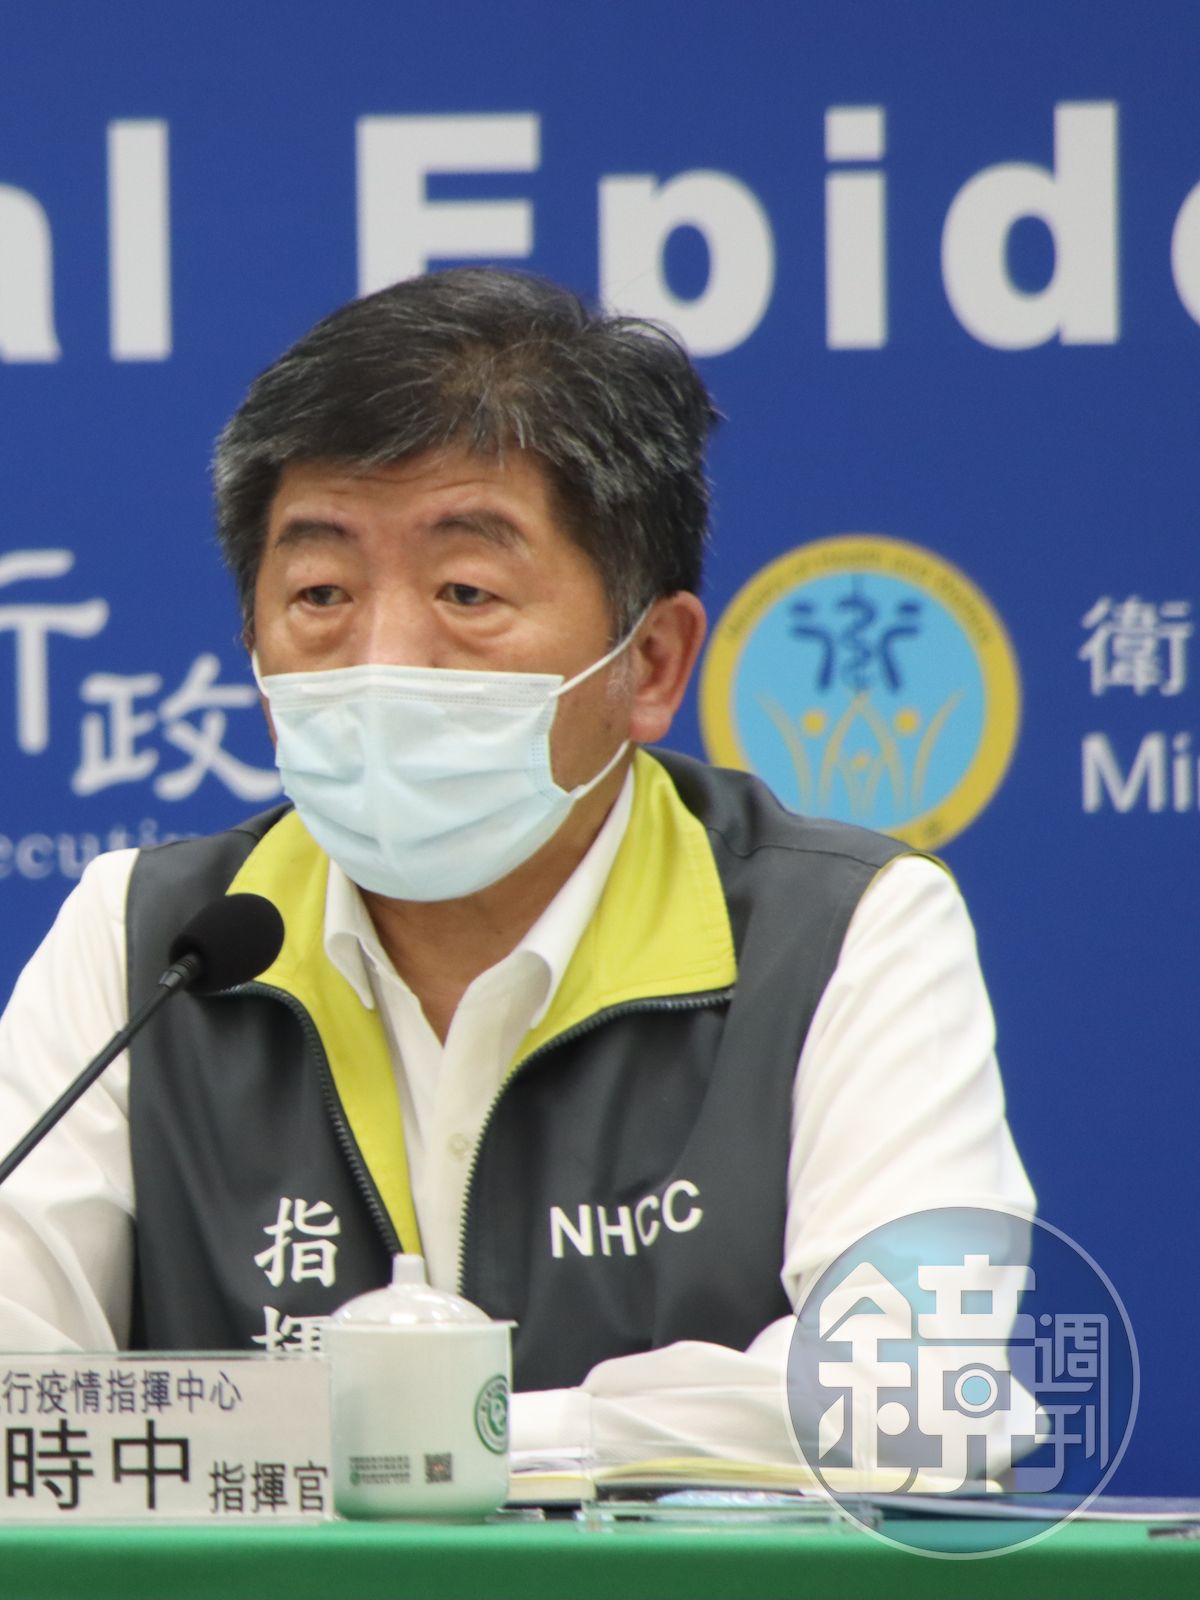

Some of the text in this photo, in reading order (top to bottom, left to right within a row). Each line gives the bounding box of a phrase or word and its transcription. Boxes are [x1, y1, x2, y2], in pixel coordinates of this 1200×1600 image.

[355, 98, 1200, 358] Epid
[1079, 596, 1192, 697] 衛
[1081, 731, 1200, 814] Mi
[550, 1180, 703, 1259] NHCC
[208, 1458, 330, 1515] 指揮官
